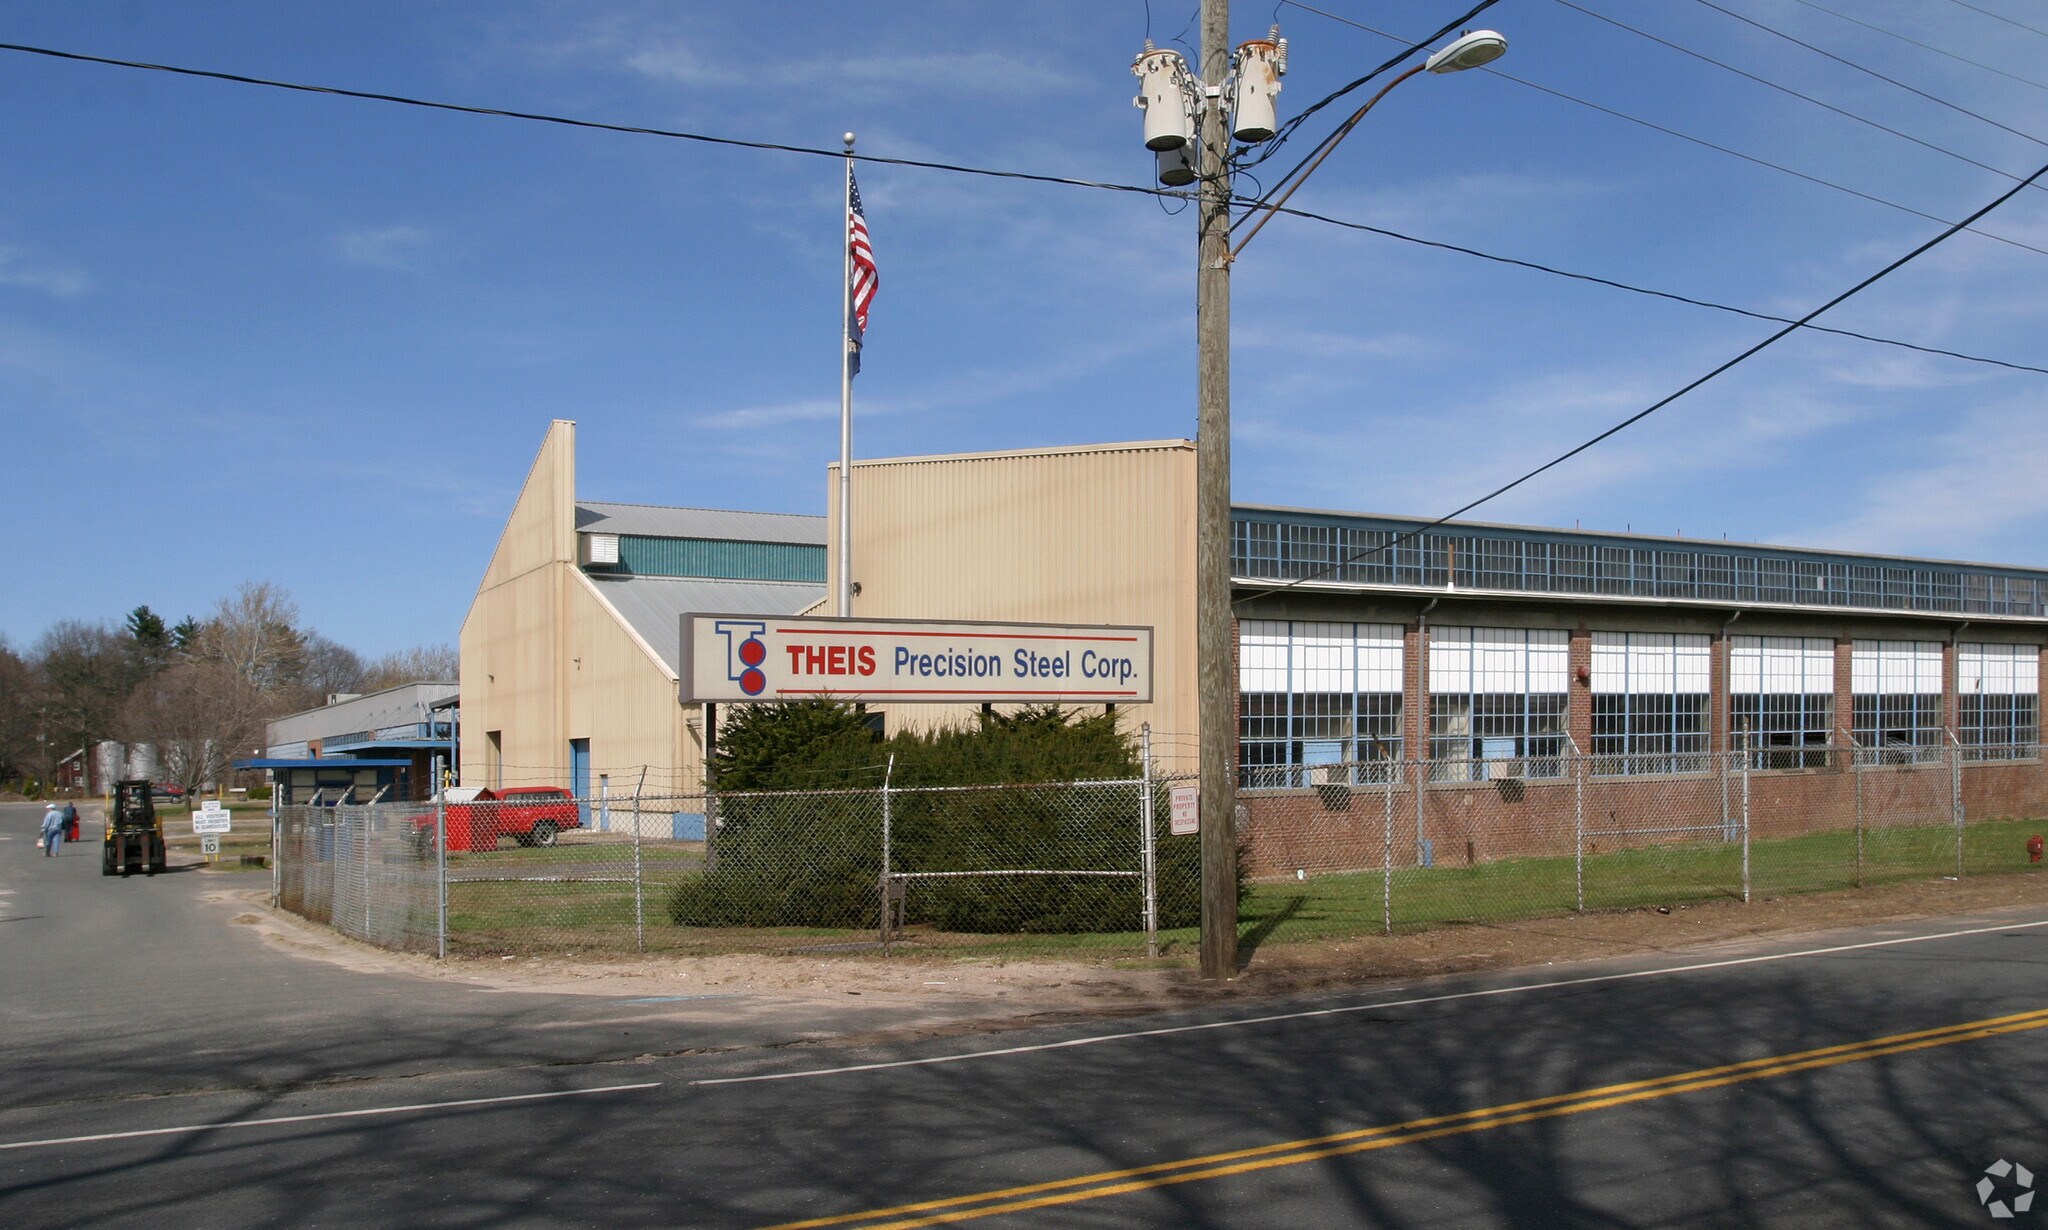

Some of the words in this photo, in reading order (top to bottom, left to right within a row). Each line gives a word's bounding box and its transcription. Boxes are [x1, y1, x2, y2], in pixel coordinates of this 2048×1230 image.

[786, 645, 876, 676] THEIS
[894, 646, 1001, 678] Precision
[1013, 648, 1070, 679] Steel
[1081, 651, 1138, 685] Corp.
[1173, 802, 1195, 810] PROPERTY
[205, 843, 216, 852] 10
